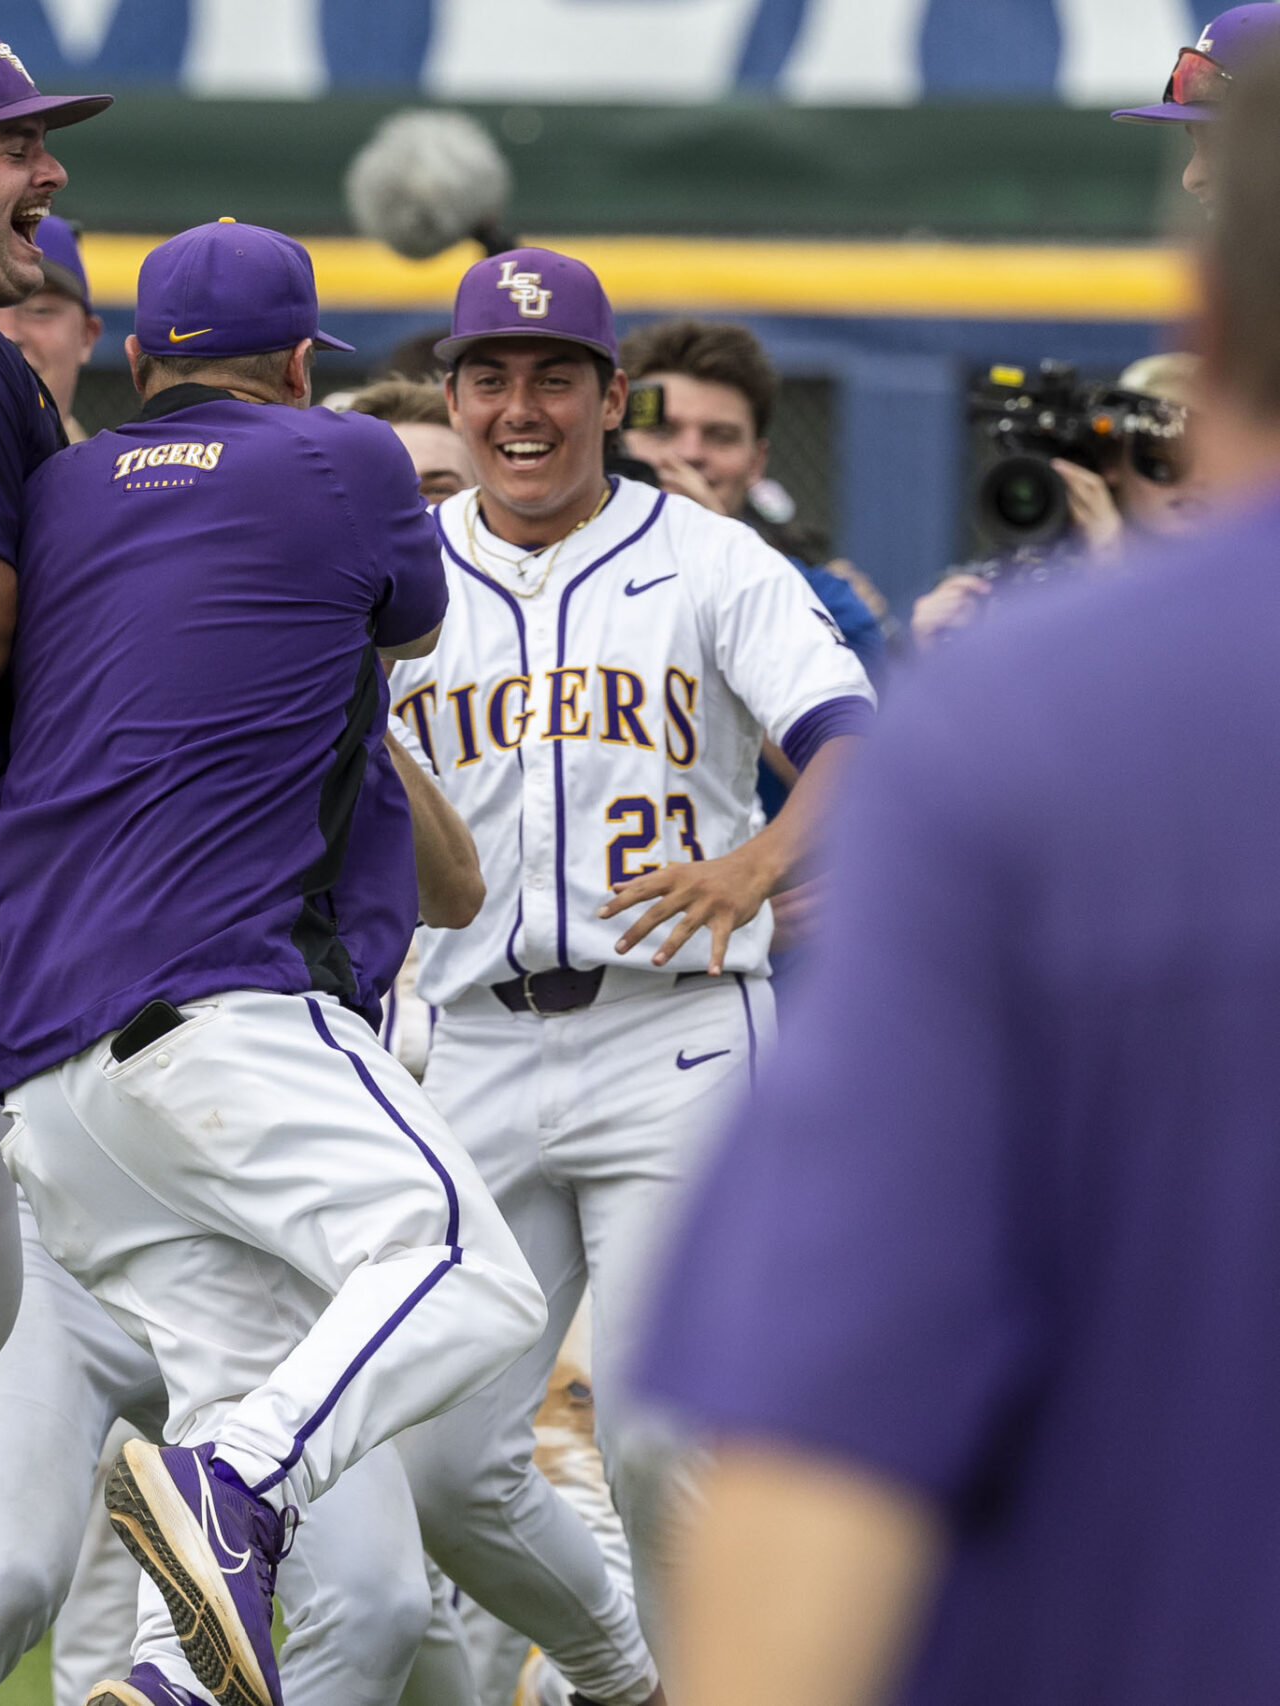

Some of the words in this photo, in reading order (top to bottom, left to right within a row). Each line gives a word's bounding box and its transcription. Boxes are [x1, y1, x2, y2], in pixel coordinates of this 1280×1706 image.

[496, 260, 554, 319] LSU
[114, 441, 224, 480] TIGERS
[125, 478, 194, 489] BASEBALL
[392, 663, 700, 778] TIGERS
[605, 792, 706, 891] 23
